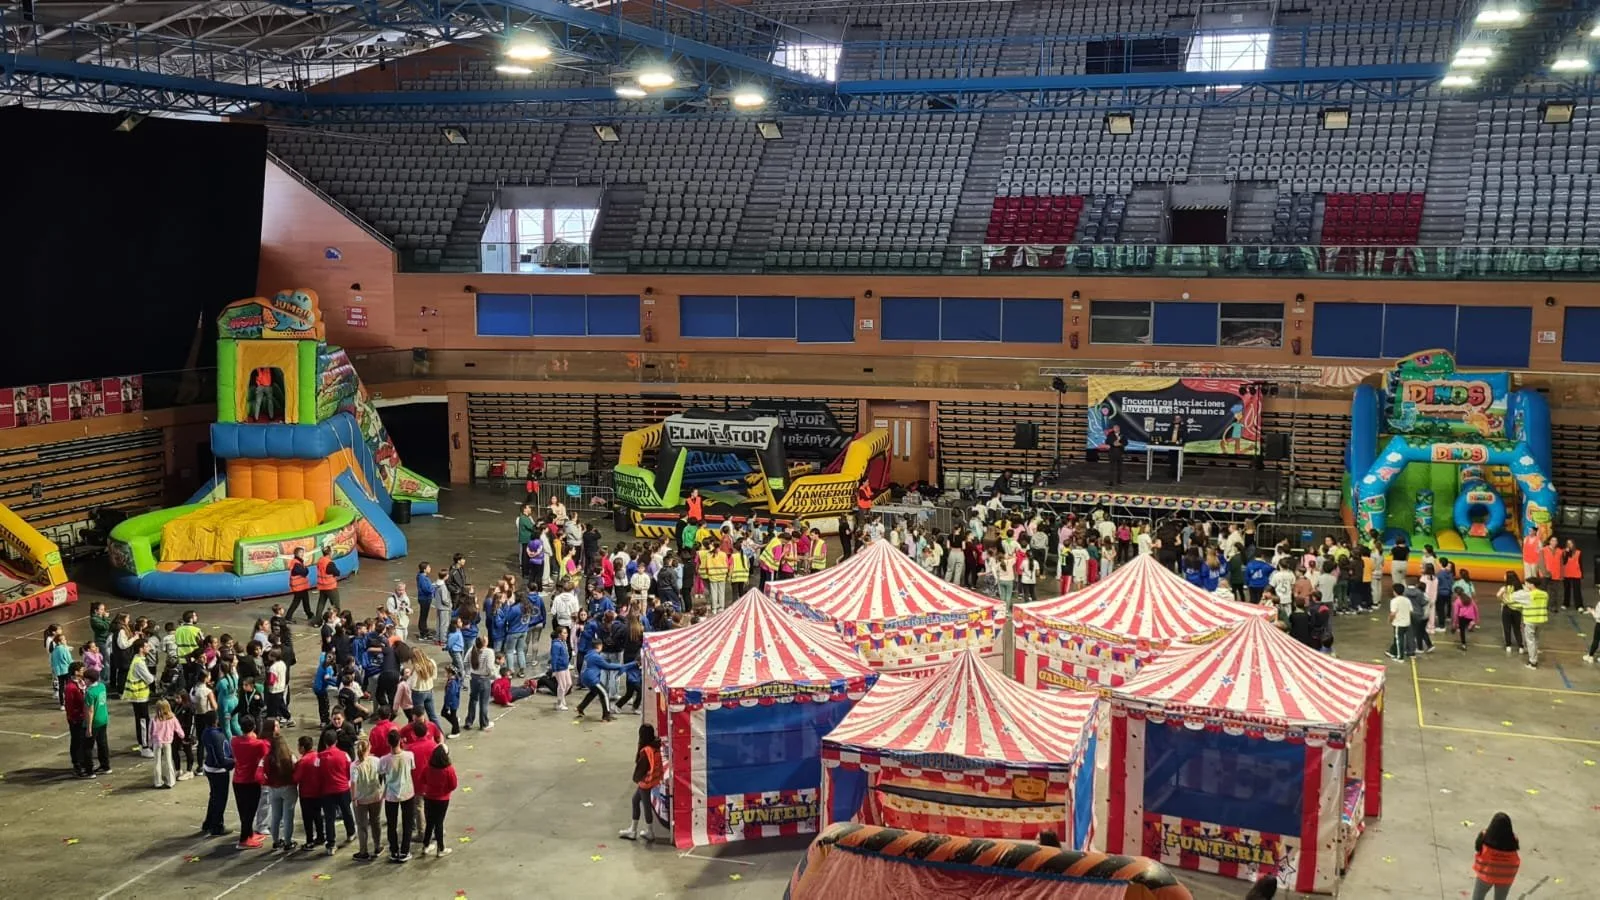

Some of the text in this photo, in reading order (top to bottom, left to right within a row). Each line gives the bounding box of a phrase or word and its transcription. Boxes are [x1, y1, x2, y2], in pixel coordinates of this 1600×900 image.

[1409, 384, 1486, 406] DINOS
[1122, 397, 1225, 408] Encuentros Asociaciones
[1174, 407, 1225, 416] Salamanca
[1436, 447, 1483, 462] DINOS
[793, 498, 807, 507] DO
[810, 497, 828, 506] NOT
